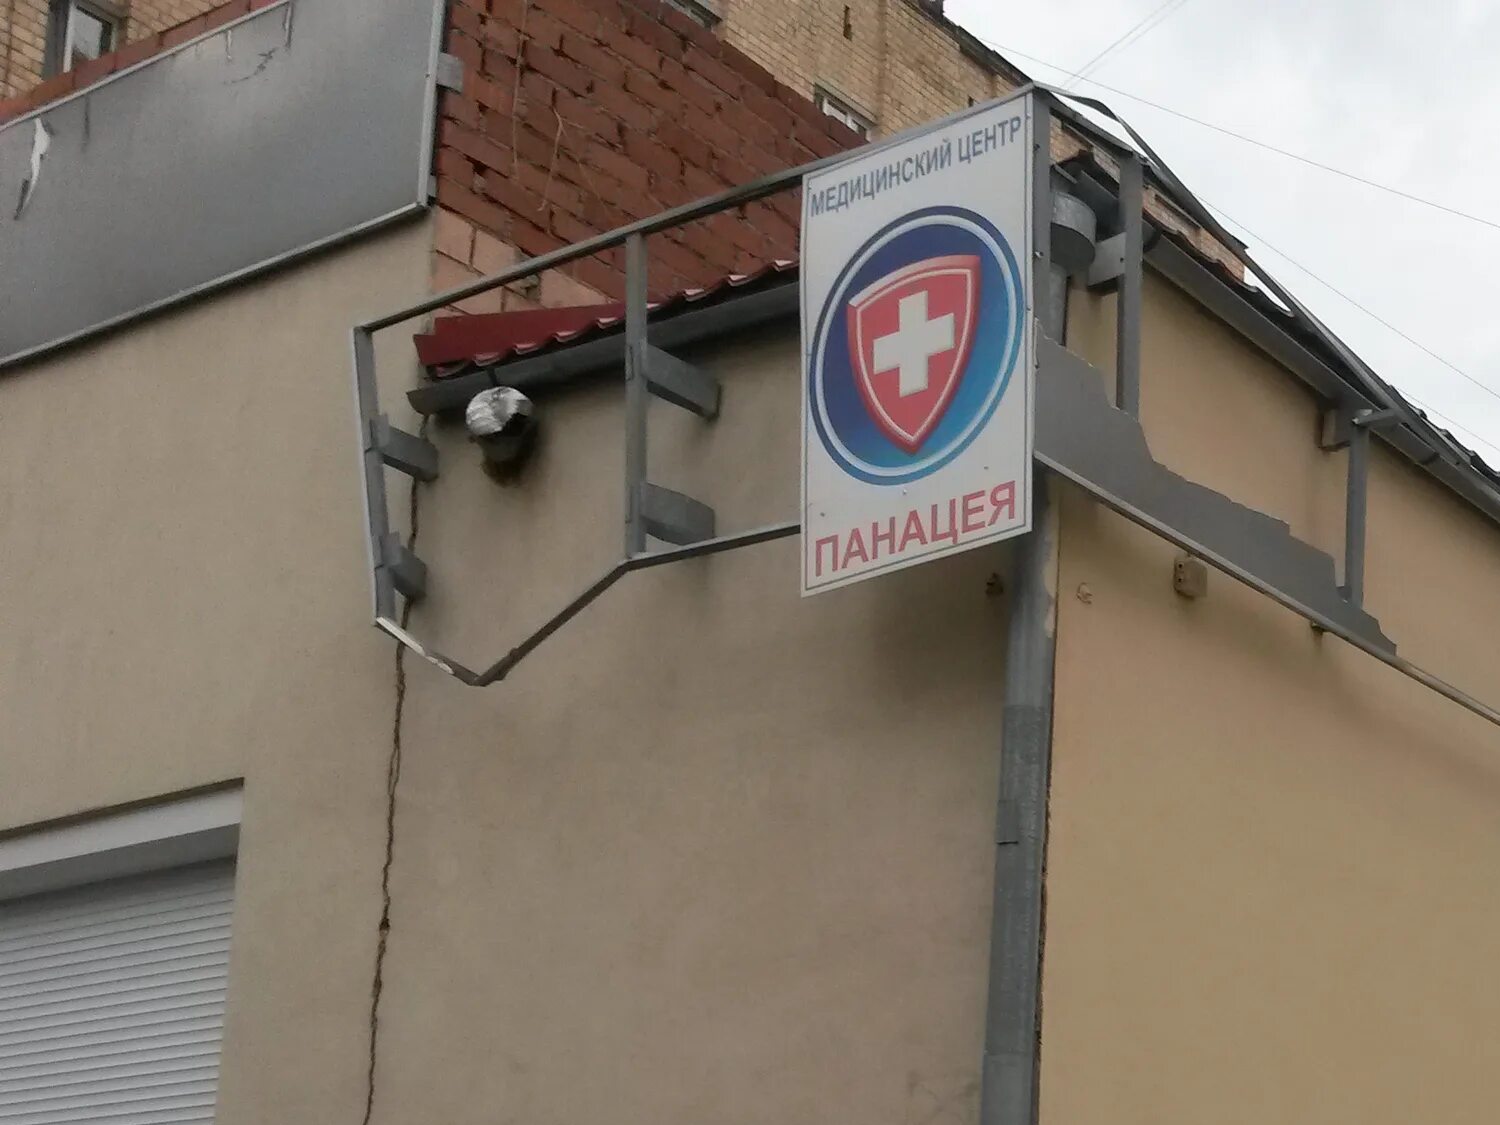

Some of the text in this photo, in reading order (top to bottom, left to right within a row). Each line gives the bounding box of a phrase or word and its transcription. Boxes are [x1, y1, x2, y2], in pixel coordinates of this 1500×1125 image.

[810, 115, 1022, 217] МЕДИЦИНСКИЙ ЦЕНТР
[815, 480, 1016, 577] ПАНАЦЕЯ
